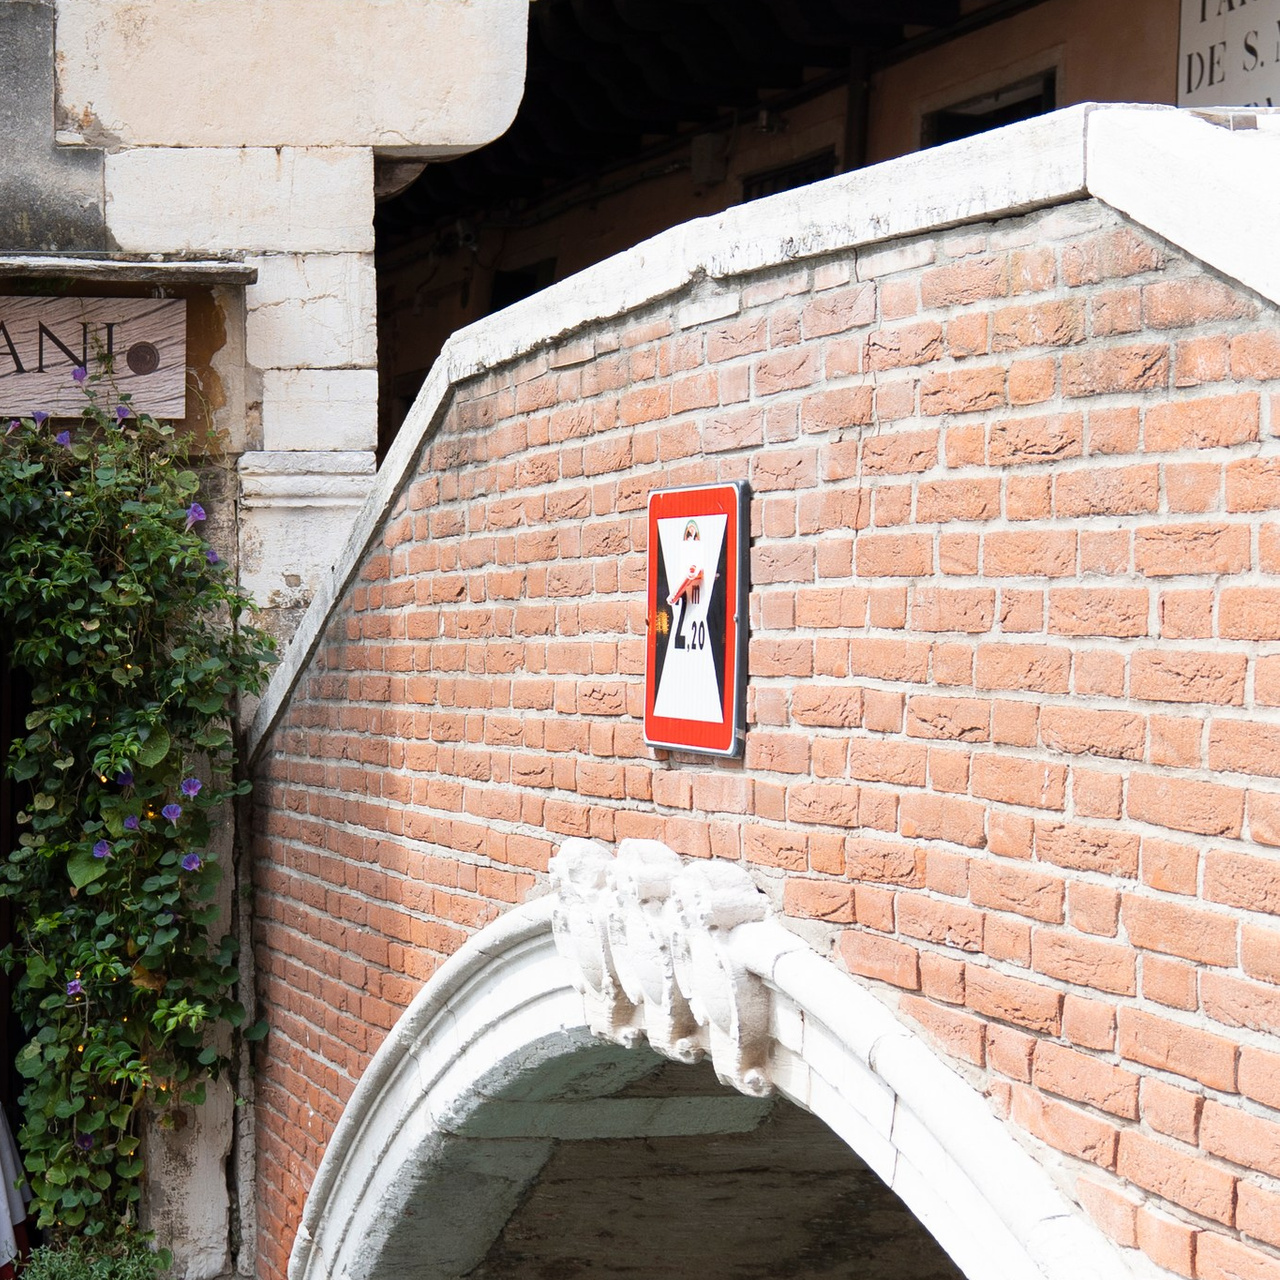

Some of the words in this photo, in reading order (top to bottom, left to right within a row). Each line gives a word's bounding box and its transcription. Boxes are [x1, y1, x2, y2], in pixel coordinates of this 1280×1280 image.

[1185, 41, 1227, 95] DE
[1243, 30, 1265, 72] S.
[674, 590, 706, 653] 2,20
